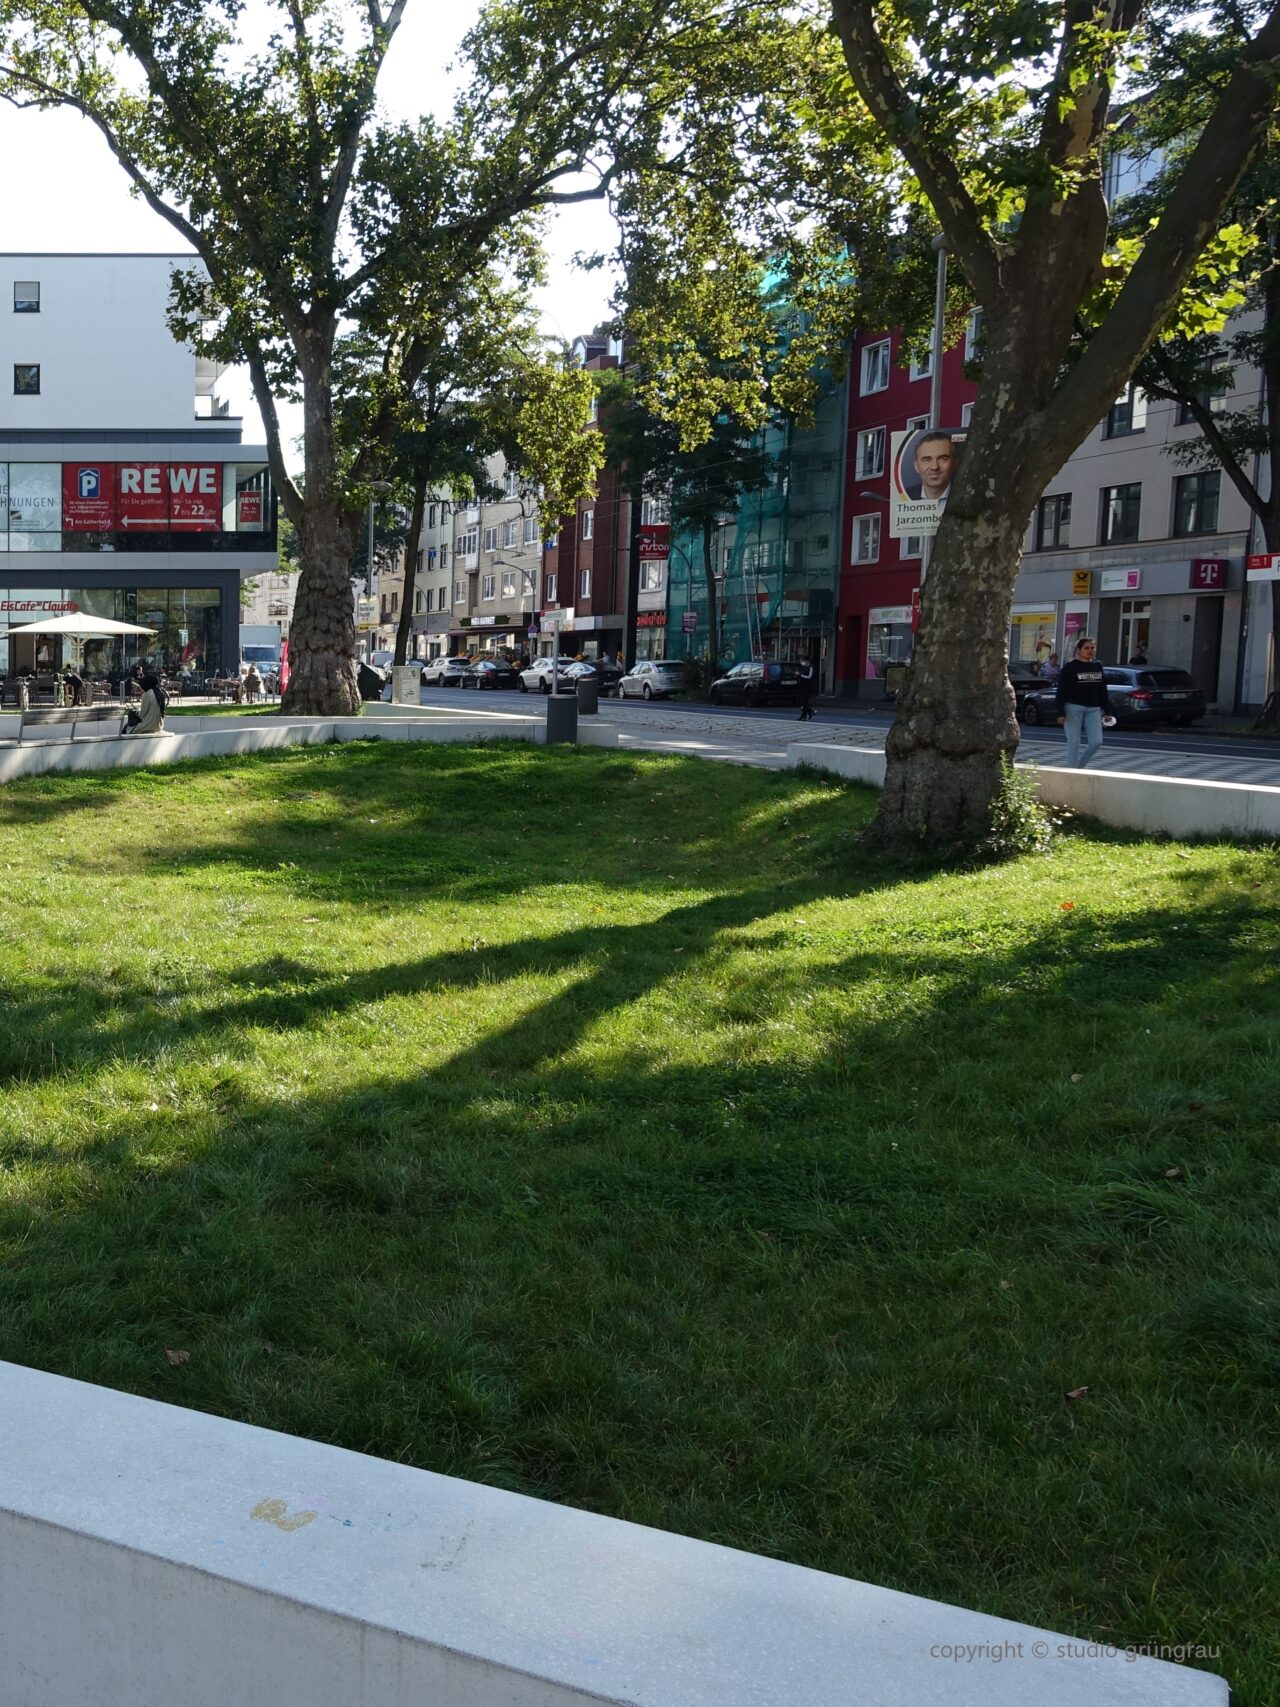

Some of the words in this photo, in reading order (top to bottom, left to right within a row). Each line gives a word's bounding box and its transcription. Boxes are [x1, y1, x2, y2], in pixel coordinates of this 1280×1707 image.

[121, 468, 217, 494] REWE
[240, 496, 261, 505] REWE
[174, 505, 180, 515] 7
[191, 505, 205, 515] 22
[897, 503, 937, 512] Thomas
